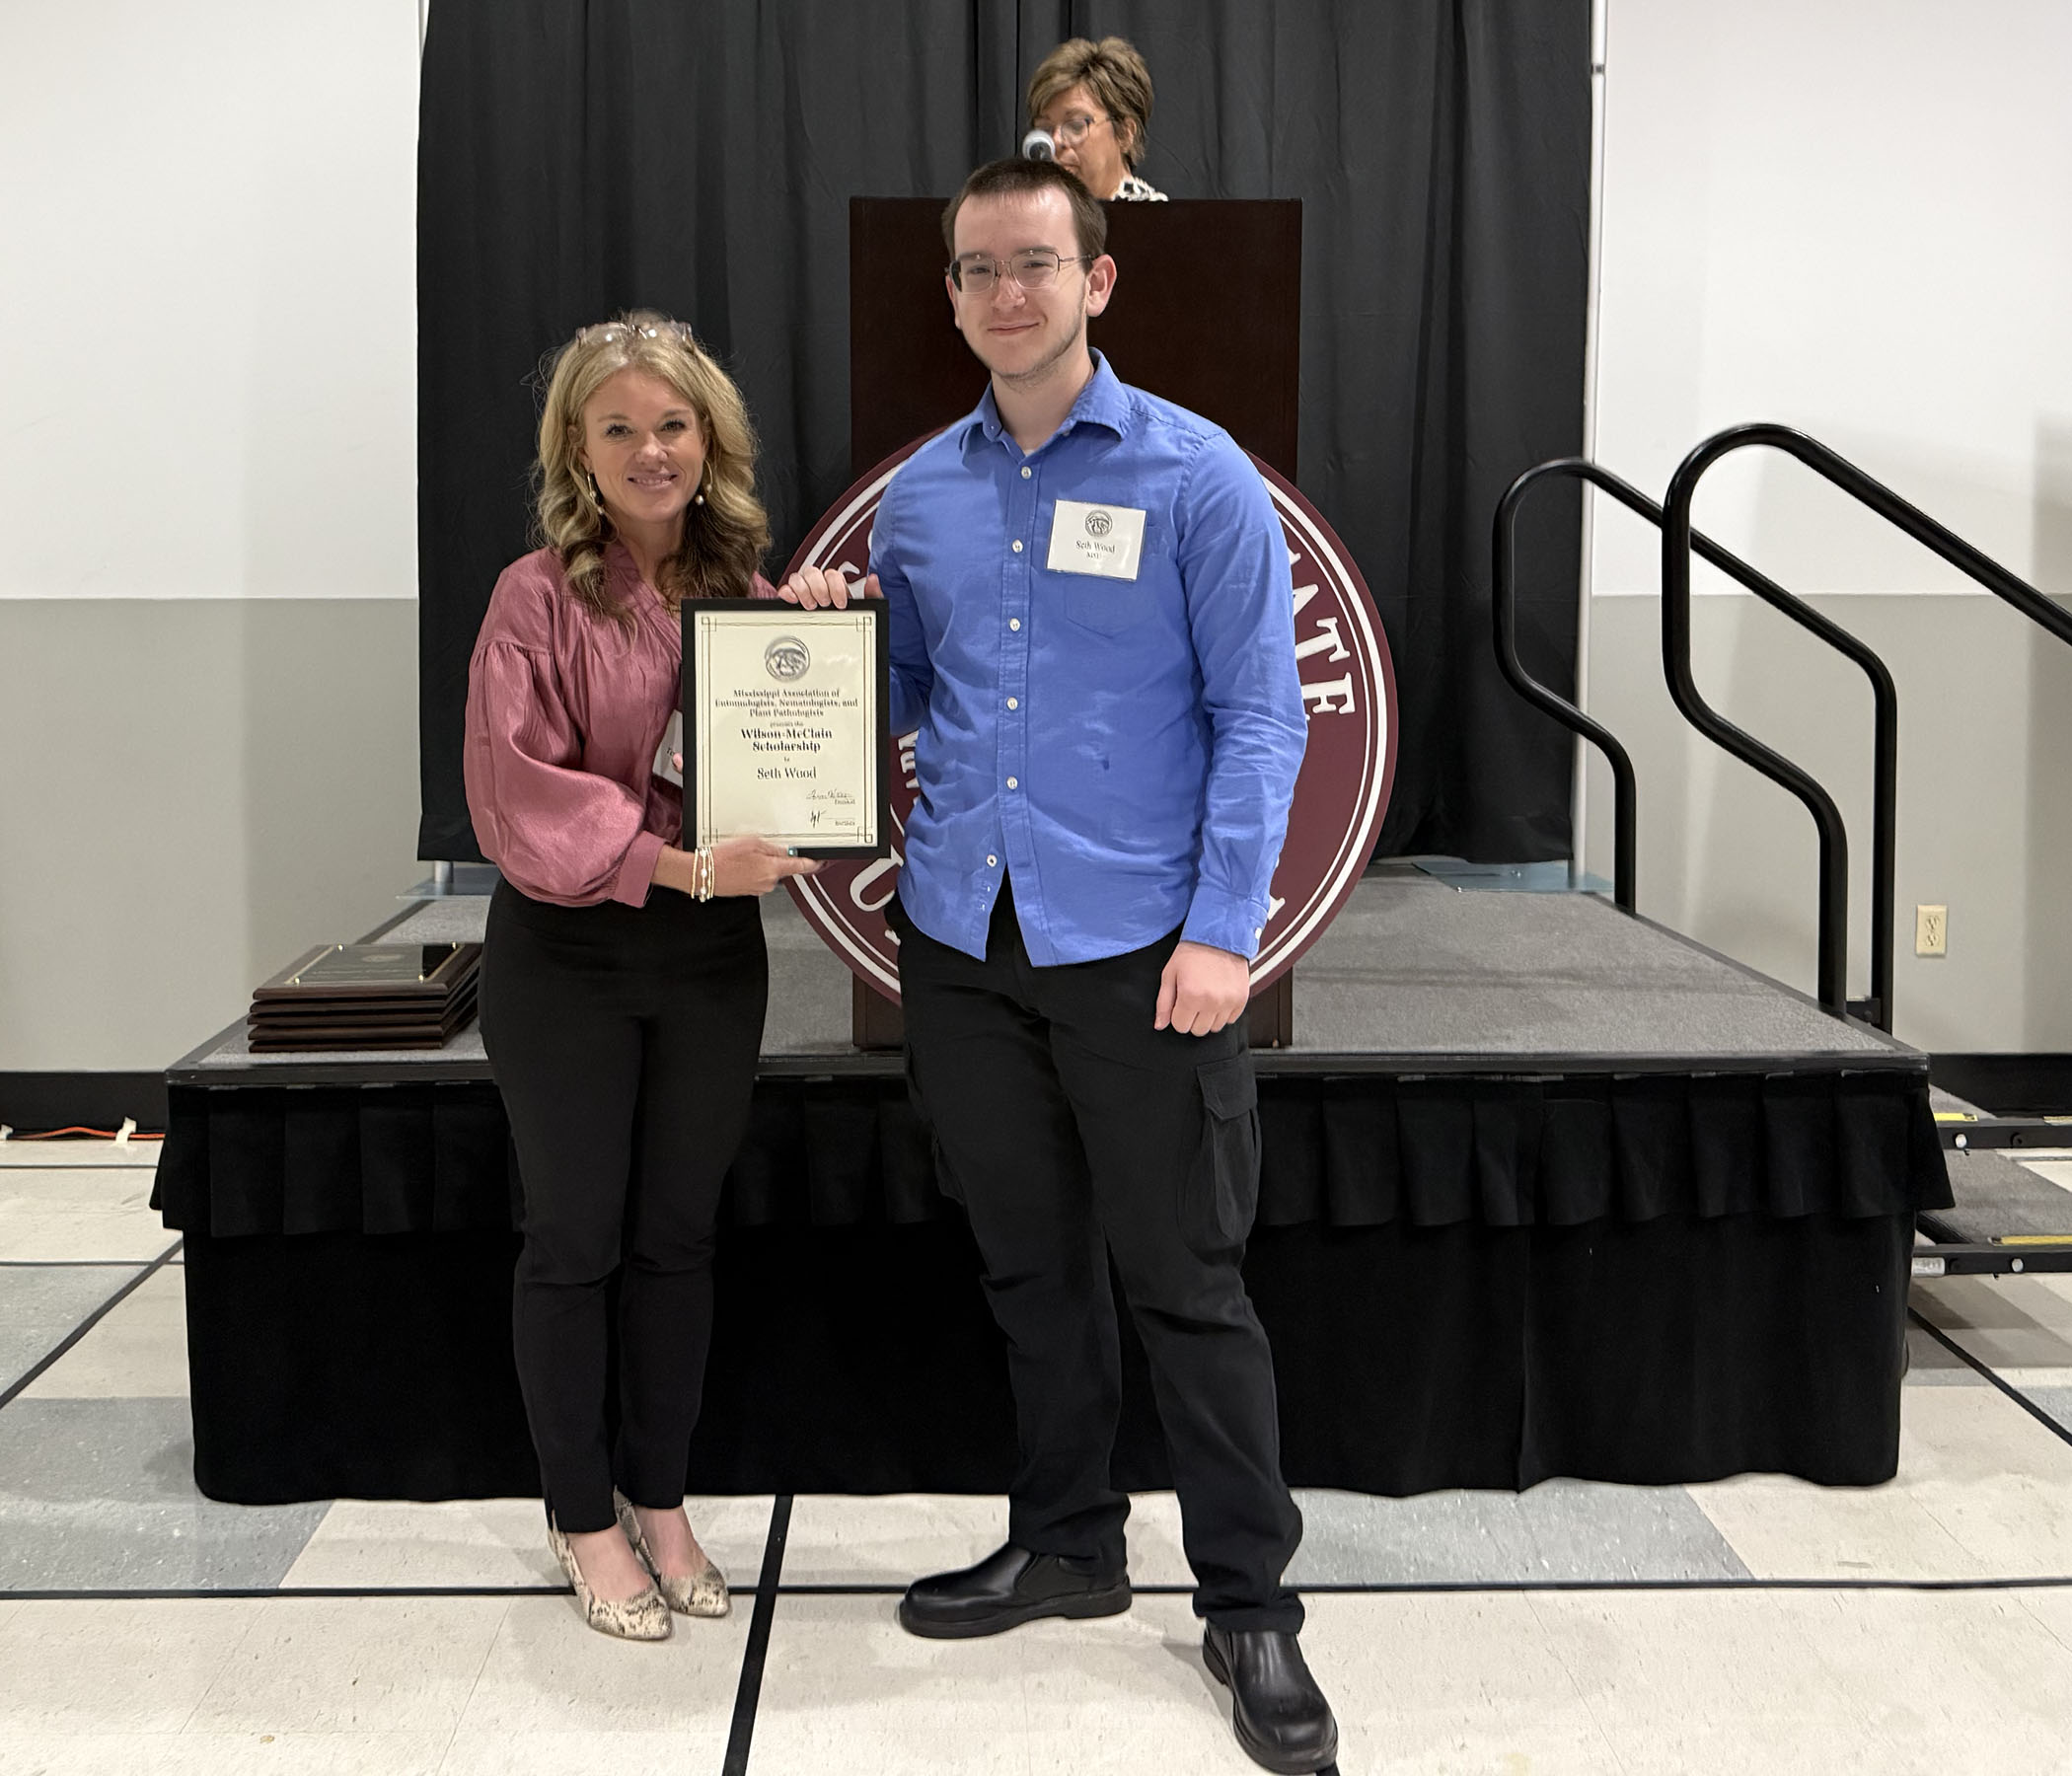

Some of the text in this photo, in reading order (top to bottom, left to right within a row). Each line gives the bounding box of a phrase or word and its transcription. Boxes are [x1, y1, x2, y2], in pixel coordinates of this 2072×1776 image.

[733, 688, 840, 700] Mississippi Association of
[842, 698, 858, 706] and
[749, 707, 824, 718] Plant Pathologists
[740, 727, 833, 739] Wilson-McClain
[752, 740, 821, 753] Scholarship
[757, 766, 817, 779] Seth Wood
